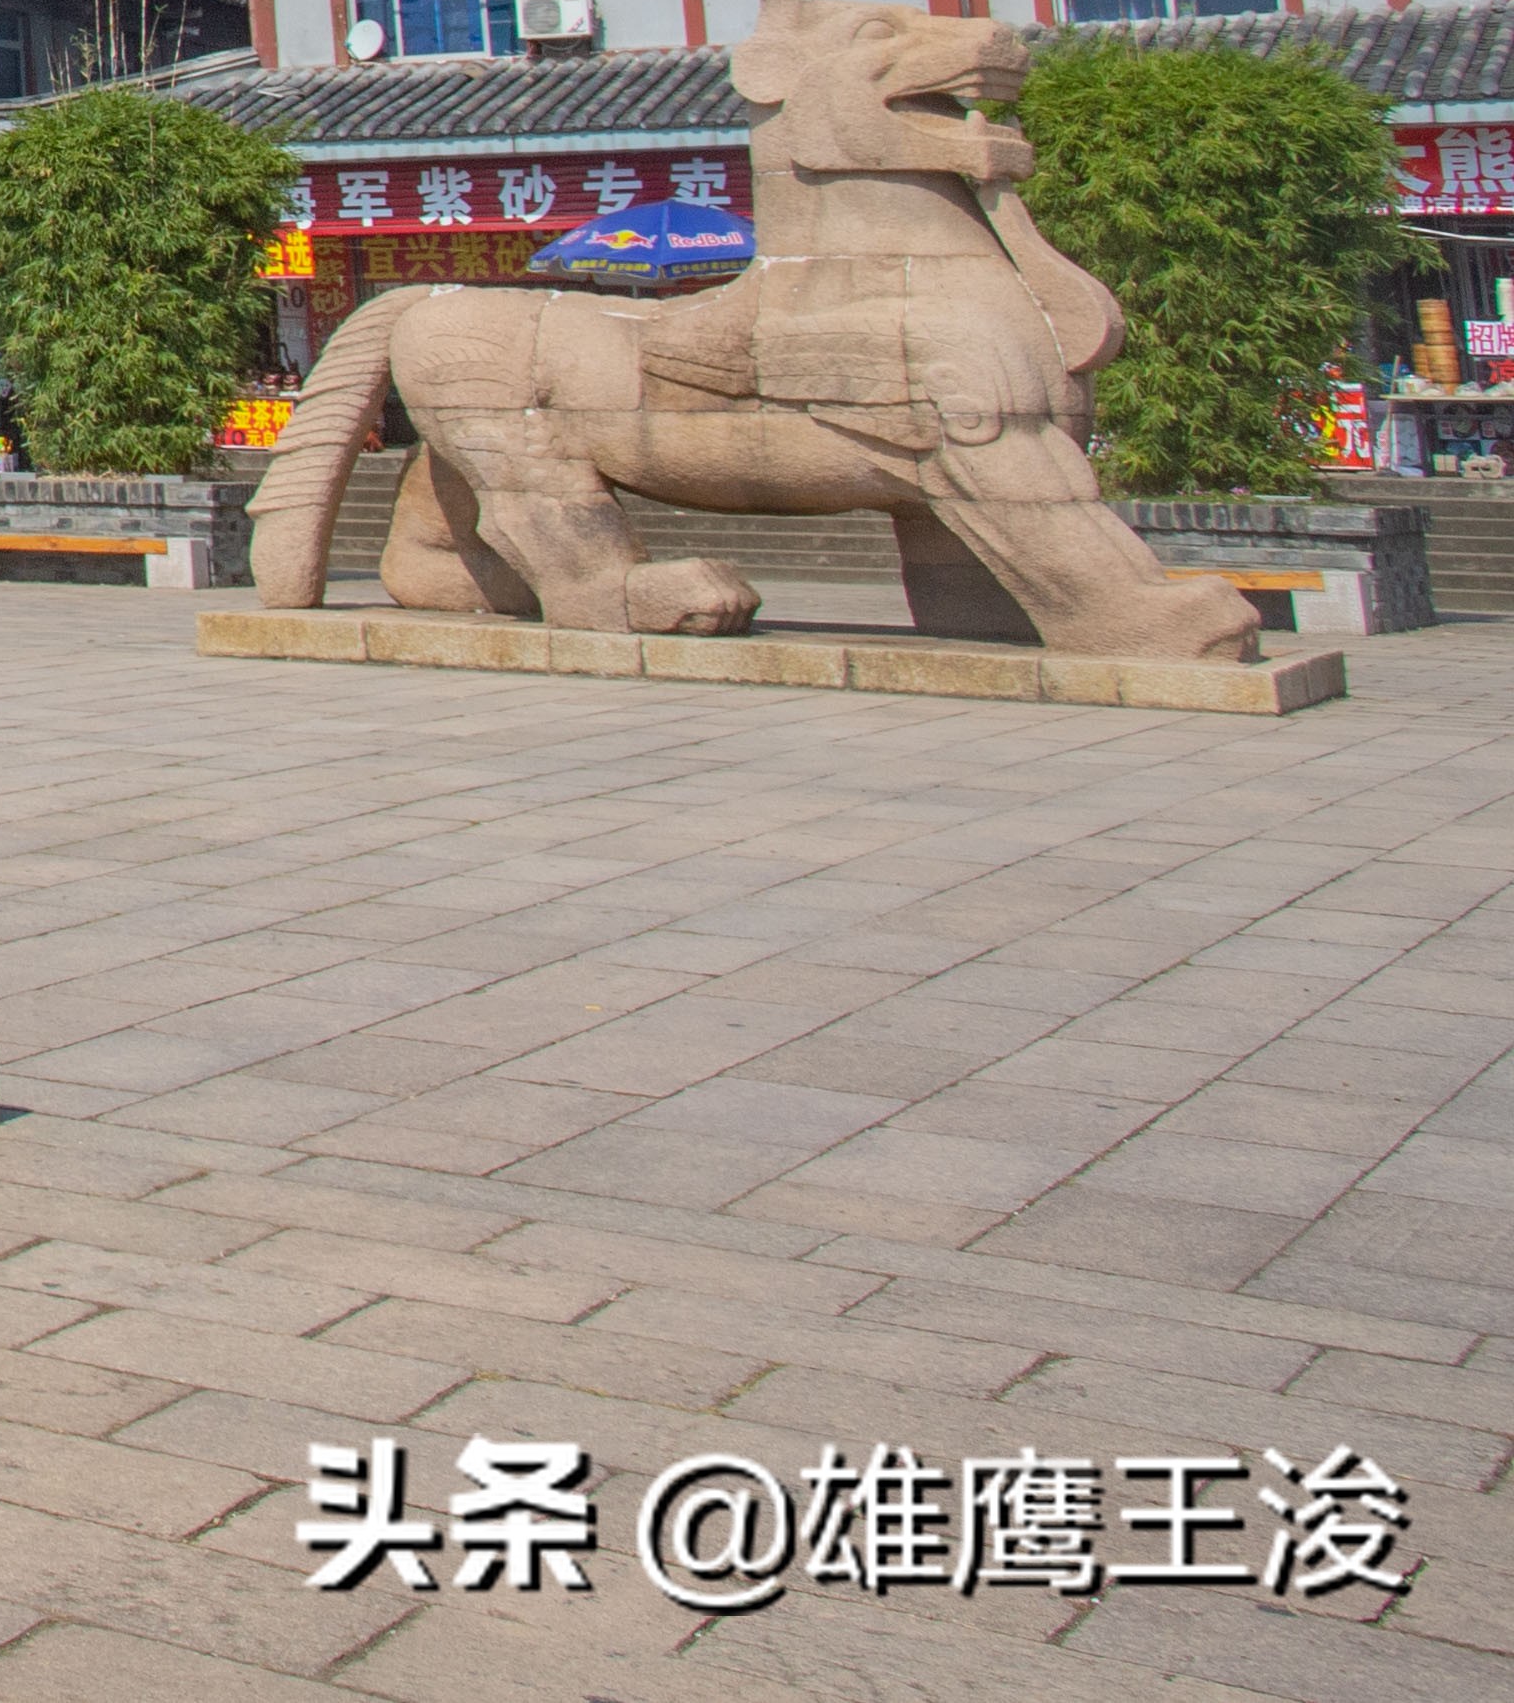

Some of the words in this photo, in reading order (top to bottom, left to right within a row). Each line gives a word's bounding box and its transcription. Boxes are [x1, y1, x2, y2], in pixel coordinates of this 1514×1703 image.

[362, 231, 565, 281] 宜兴紫砂
[666, 232, 744, 248] RedBull
